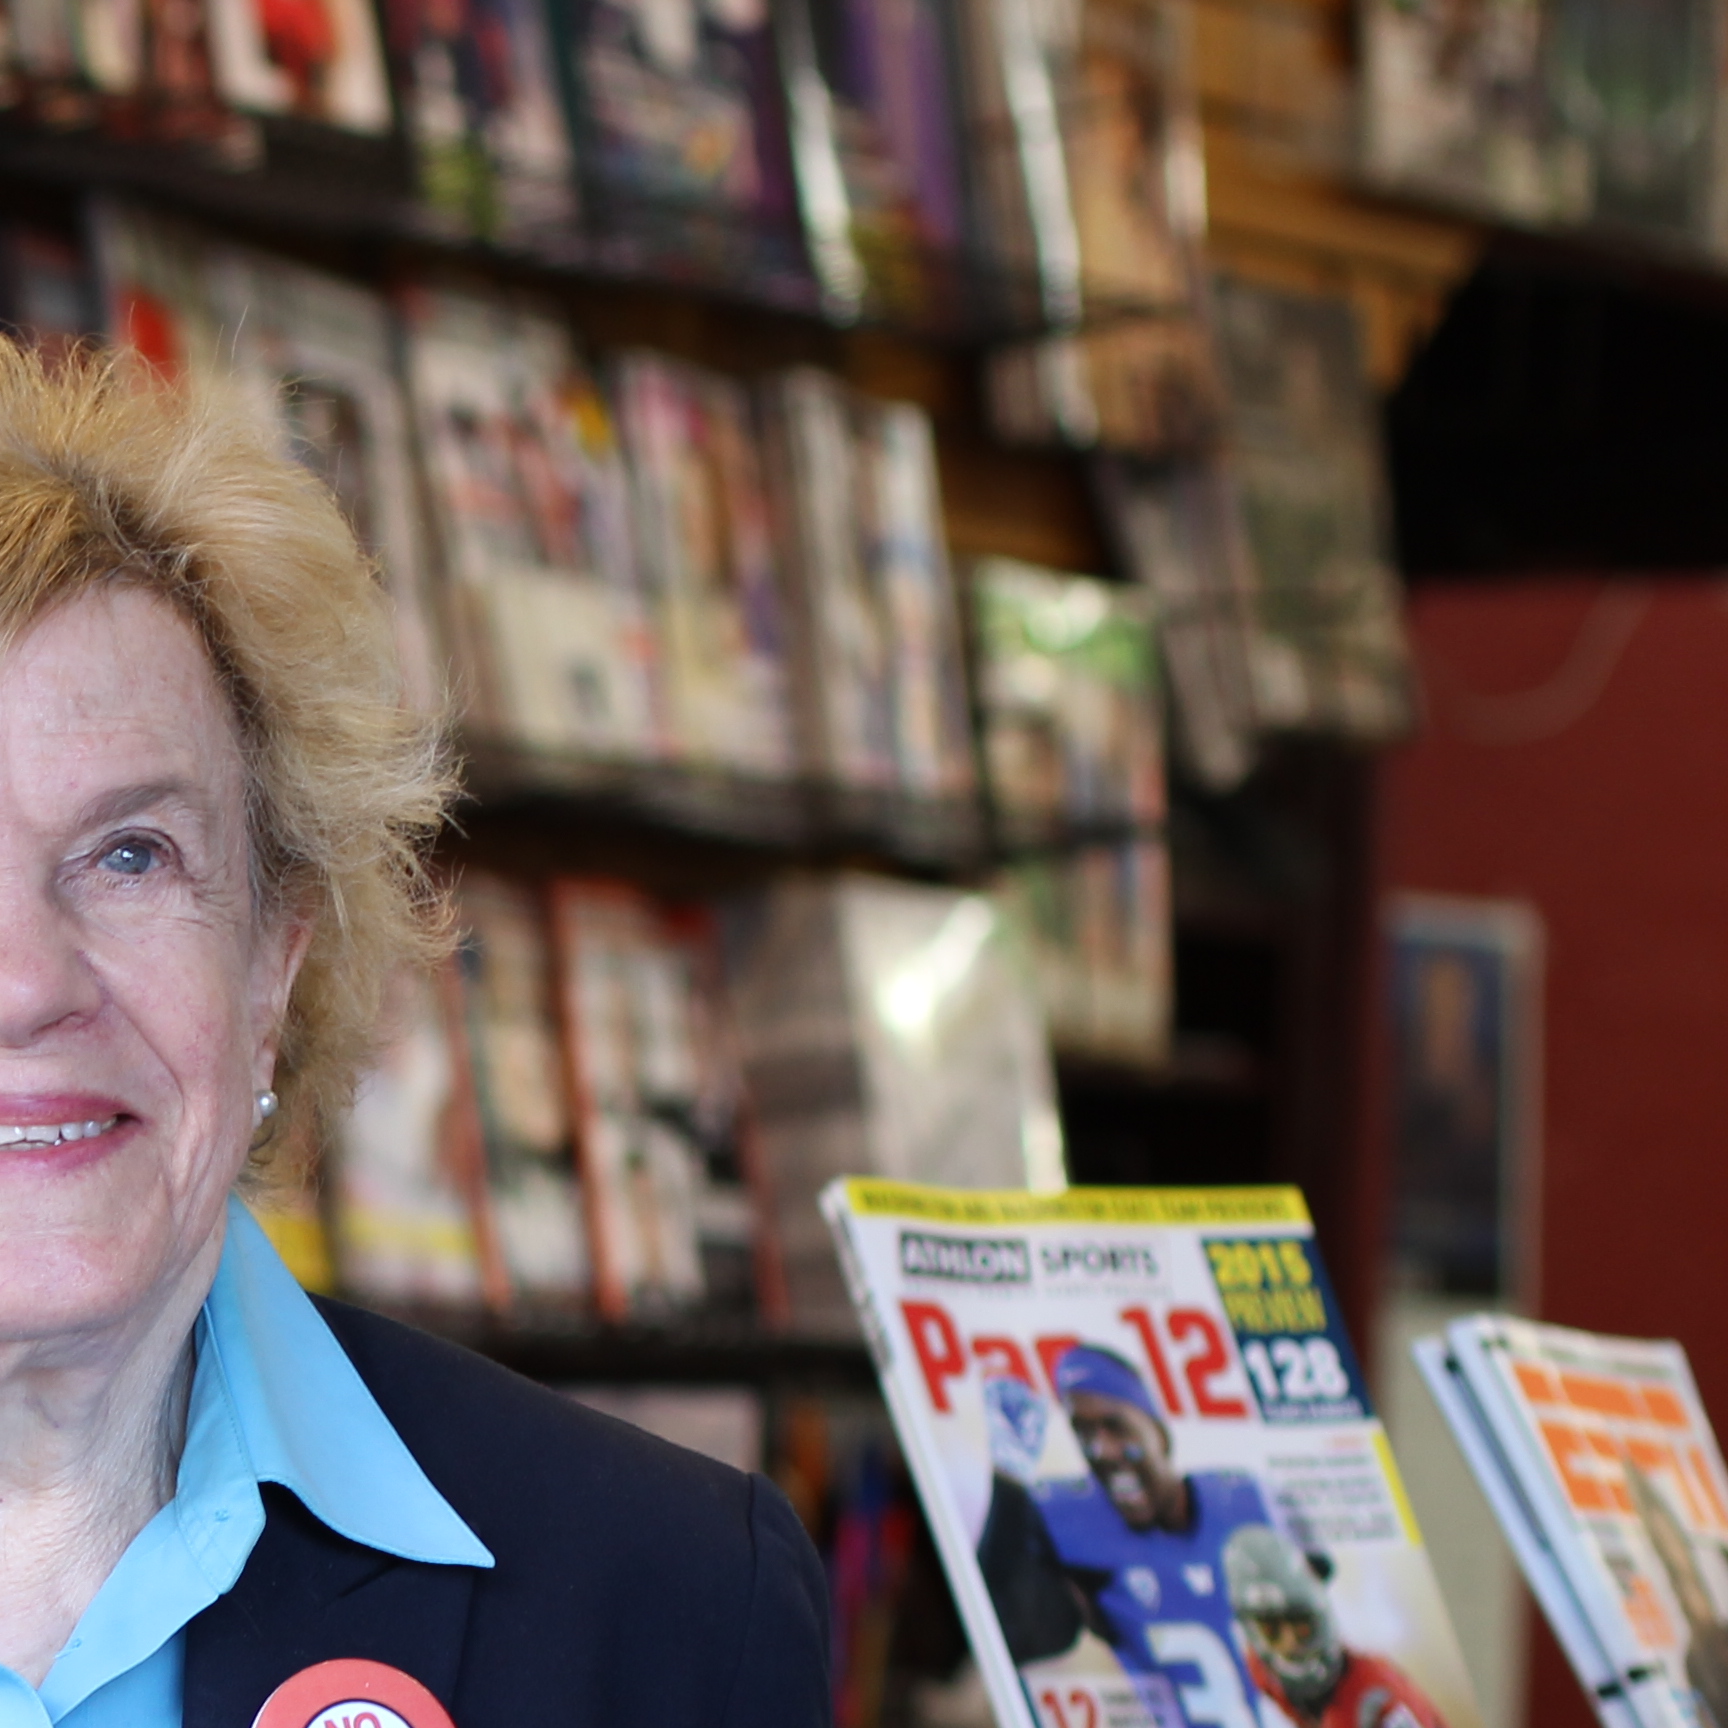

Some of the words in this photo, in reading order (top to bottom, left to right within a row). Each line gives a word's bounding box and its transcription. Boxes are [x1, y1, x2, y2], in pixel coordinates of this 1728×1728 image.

[1042, 1240, 1161, 1277] SPORTS
[1208, 1241, 1313, 1287] 2015
[1244, 1336, 1350, 1402] 128
